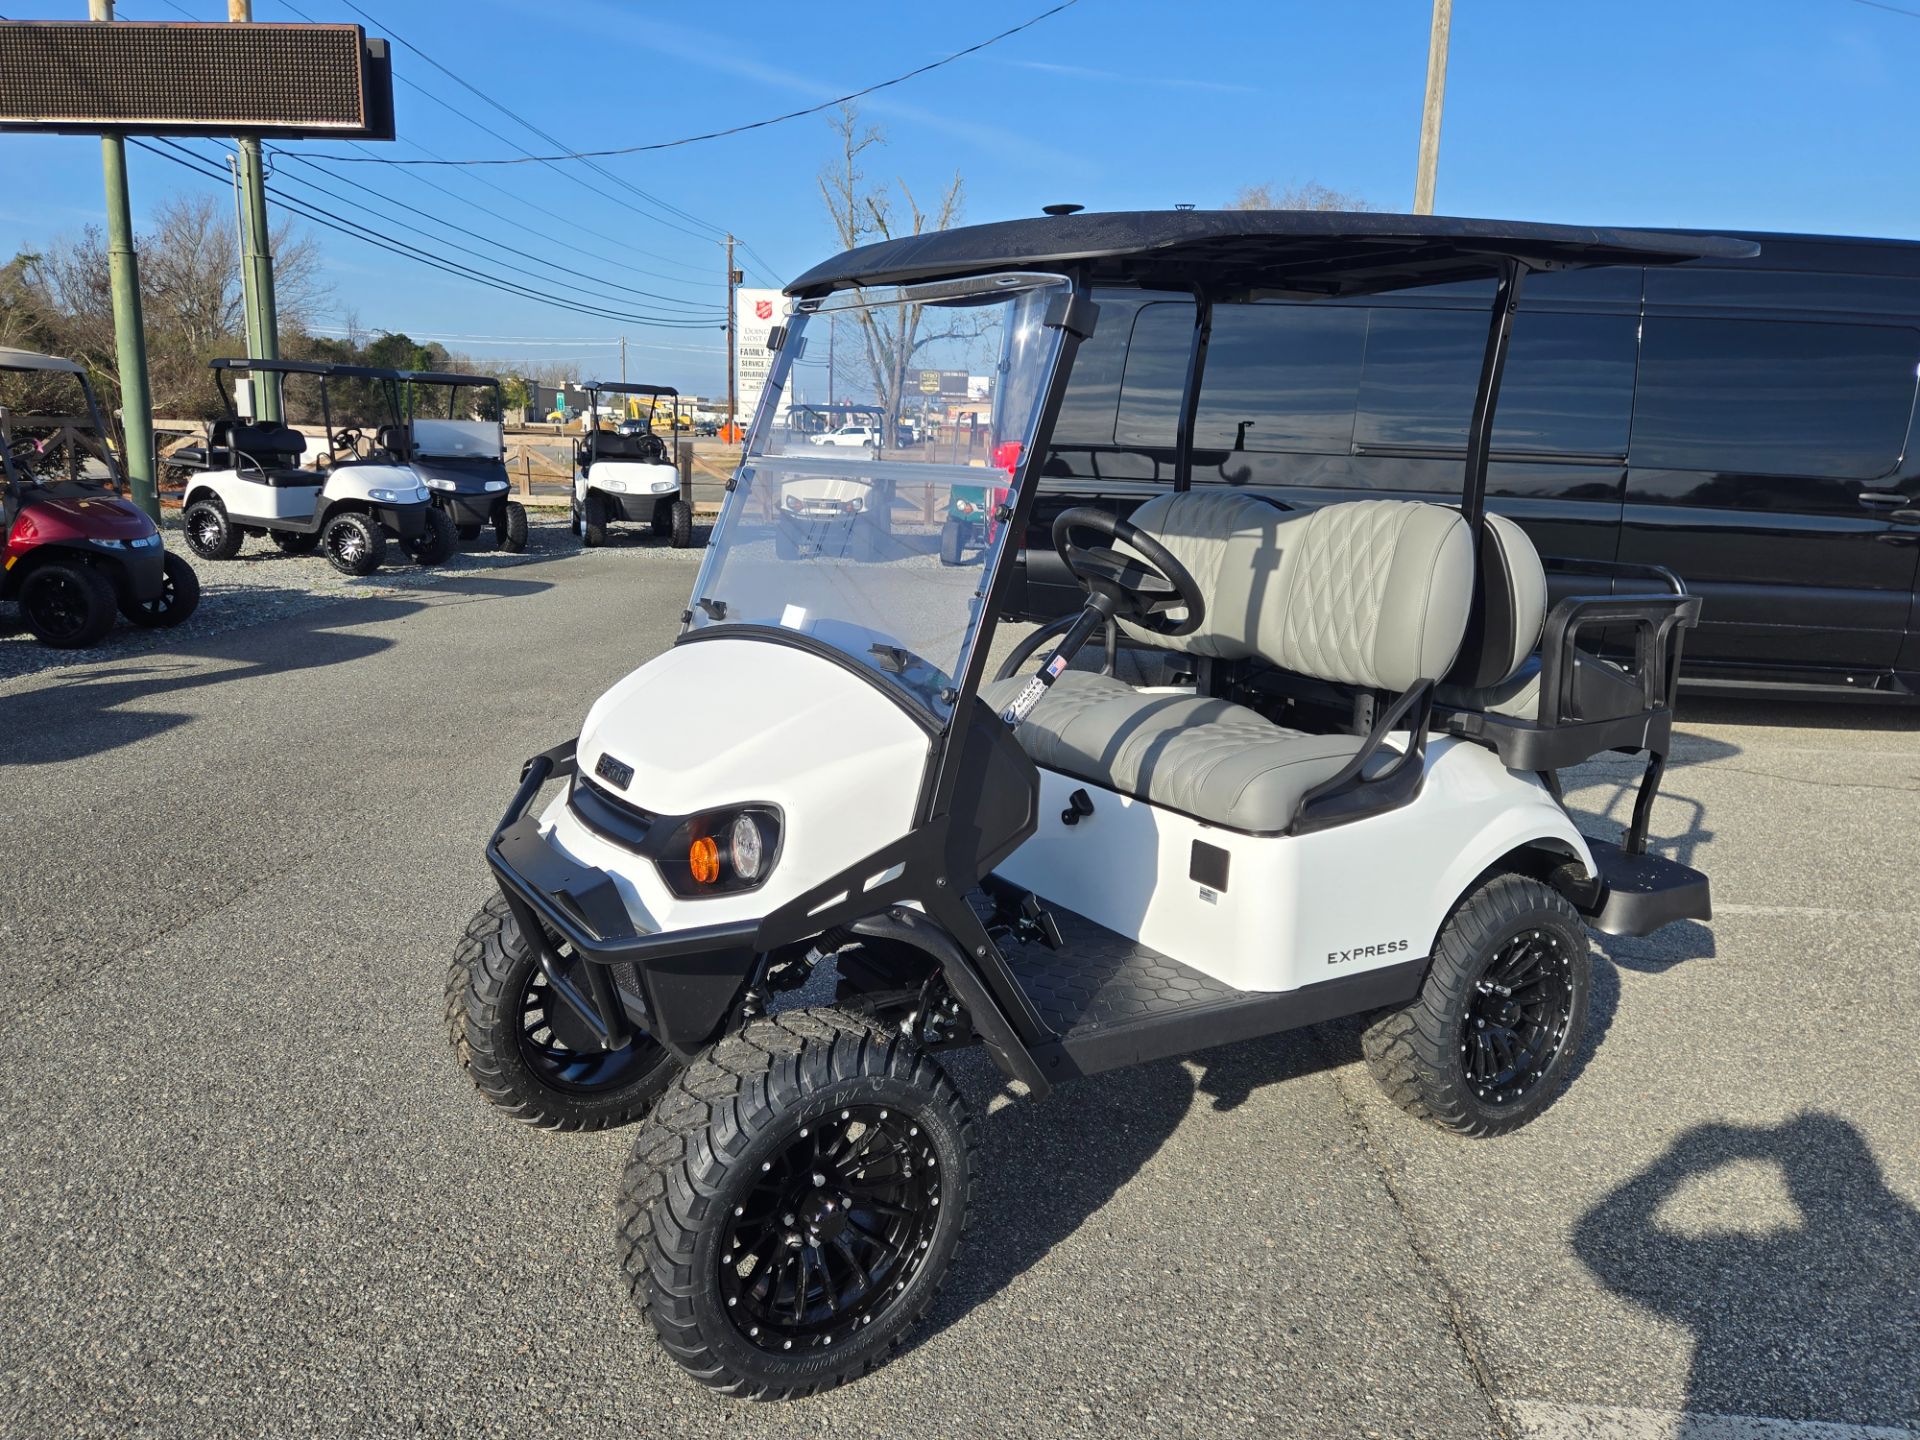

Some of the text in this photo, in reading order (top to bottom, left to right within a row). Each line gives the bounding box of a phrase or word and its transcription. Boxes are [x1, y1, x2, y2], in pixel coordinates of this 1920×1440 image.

[745, 327, 769, 335] DOING
[740, 348, 764, 356] FAMILY
[1327, 939, 1408, 964] EXPRESS
